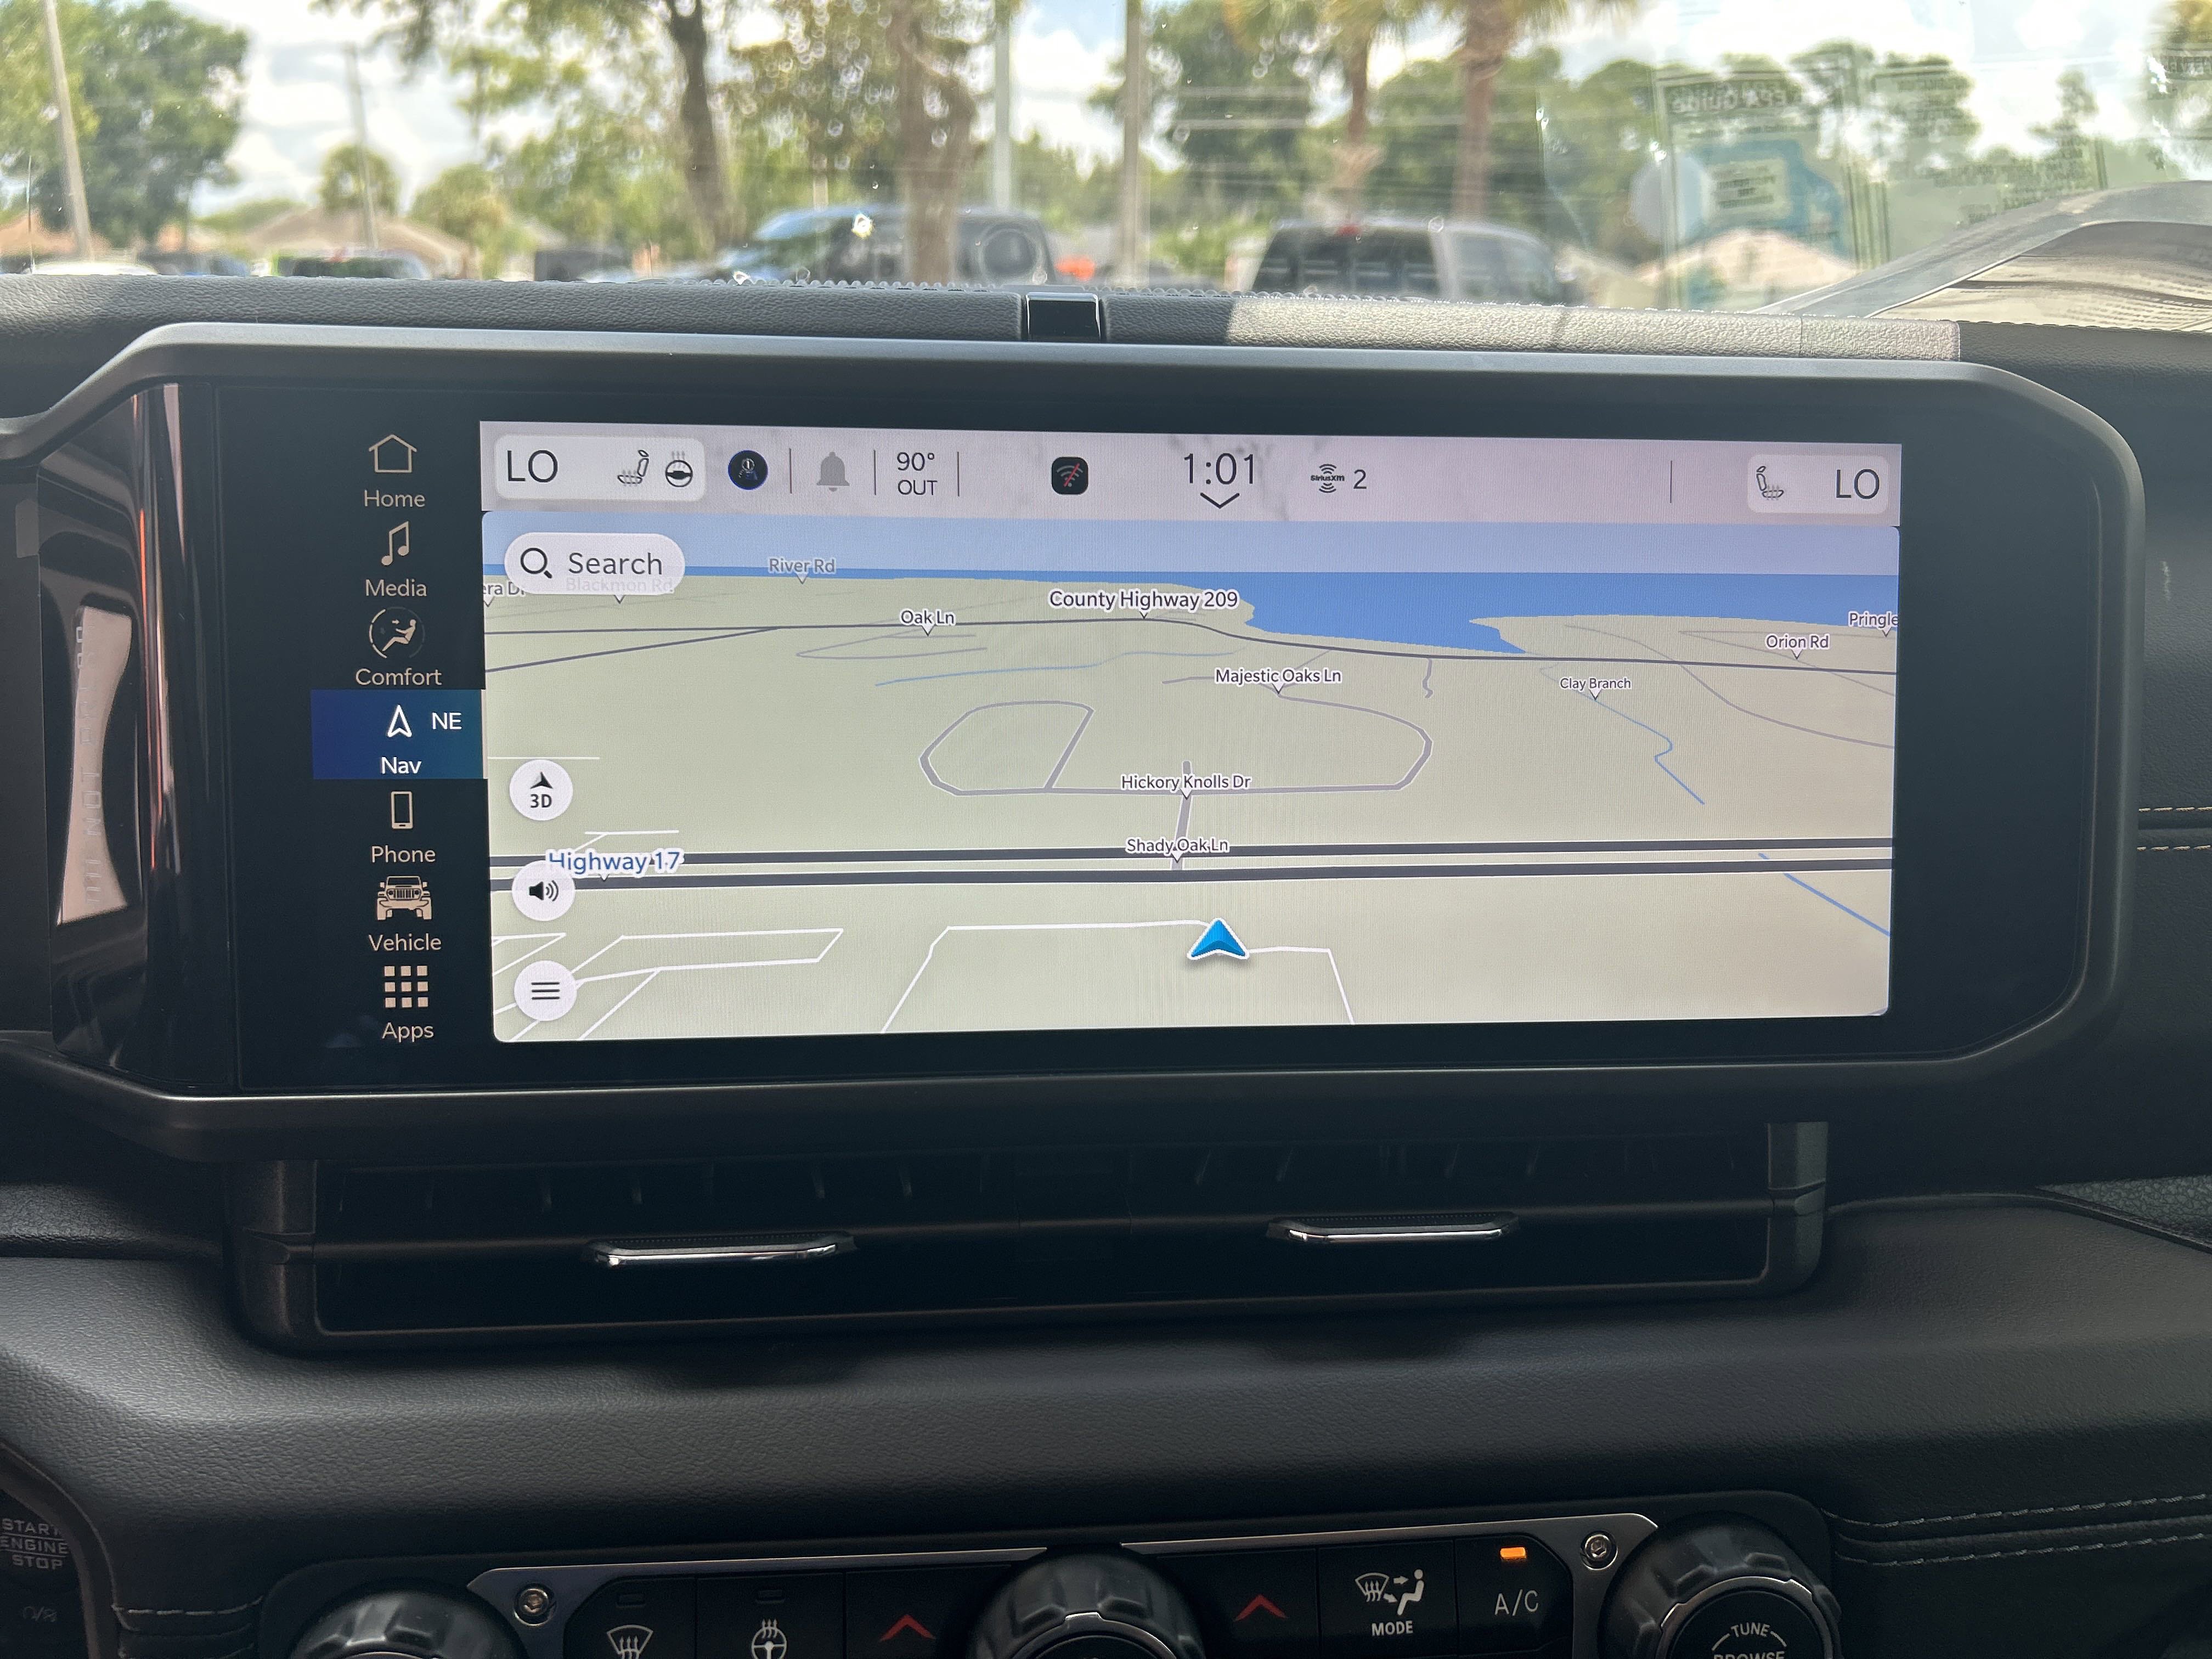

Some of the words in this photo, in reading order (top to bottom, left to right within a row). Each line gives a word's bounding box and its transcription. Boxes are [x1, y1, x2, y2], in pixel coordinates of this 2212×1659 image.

[507, 450, 558, 483] LO
[896, 452, 935, 471] 90°
[1184, 453, 1254, 485] 1:01
[898, 479, 938, 496] OUT
[1353, 469, 1367, 489] 2
[1836, 469, 1880, 500] LO
[364, 489, 425, 508] Home
[568, 552, 662, 575] Search
[769, 558, 810, 573] River
[814, 558, 836, 573] Rd
[365, 578, 427, 597] Media
[508, 582, 524, 595] D
[1050, 591, 1116, 611] County
[1120, 591, 1200, 611] Highway
[1204, 591, 1239, 608] 209
[900, 610, 933, 625] Oak
[935, 611, 955, 625] Ln
[1849, 612, 1899, 629] Pringle
[1765, 635, 1806, 649] Orion
[1810, 635, 1829, 649] Rd
[356, 668, 442, 686] Comfort
[1215, 669, 1279, 686] Majestic
[1282, 669, 1321, 683] Oaks
[1324, 669, 1341, 682] Ln
[1560, 678, 1586, 692] Clay
[1589, 678, 1632, 690] Branch
[432, 712, 462, 730] NE
[381, 757, 422, 774] Nav
[1121, 775, 1179, 791] Hickory
[1184, 775, 1229, 789] Knolls
[1233, 775, 1251, 789] Dr
[530, 793, 552, 809] 3D
[371, 845, 436, 863] Phone
[1126, 838, 1174, 854] Shady
[1177, 838, 1207, 852] Oak
[1211, 838, 1229, 852] Ln
[549, 851, 647, 874] Highway
[368, 933, 442, 951] Vehicle
[382, 1022, 434, 1042] Apps
[0, 1536, 69, 1554] ENGINE
[12, 1554, 63, 1570] STOP
[1494, 1589, 1539, 1616] A/C
[1372, 1620, 1414, 1636] MODE
[1730, 1622, 1771, 1638] TUNE
